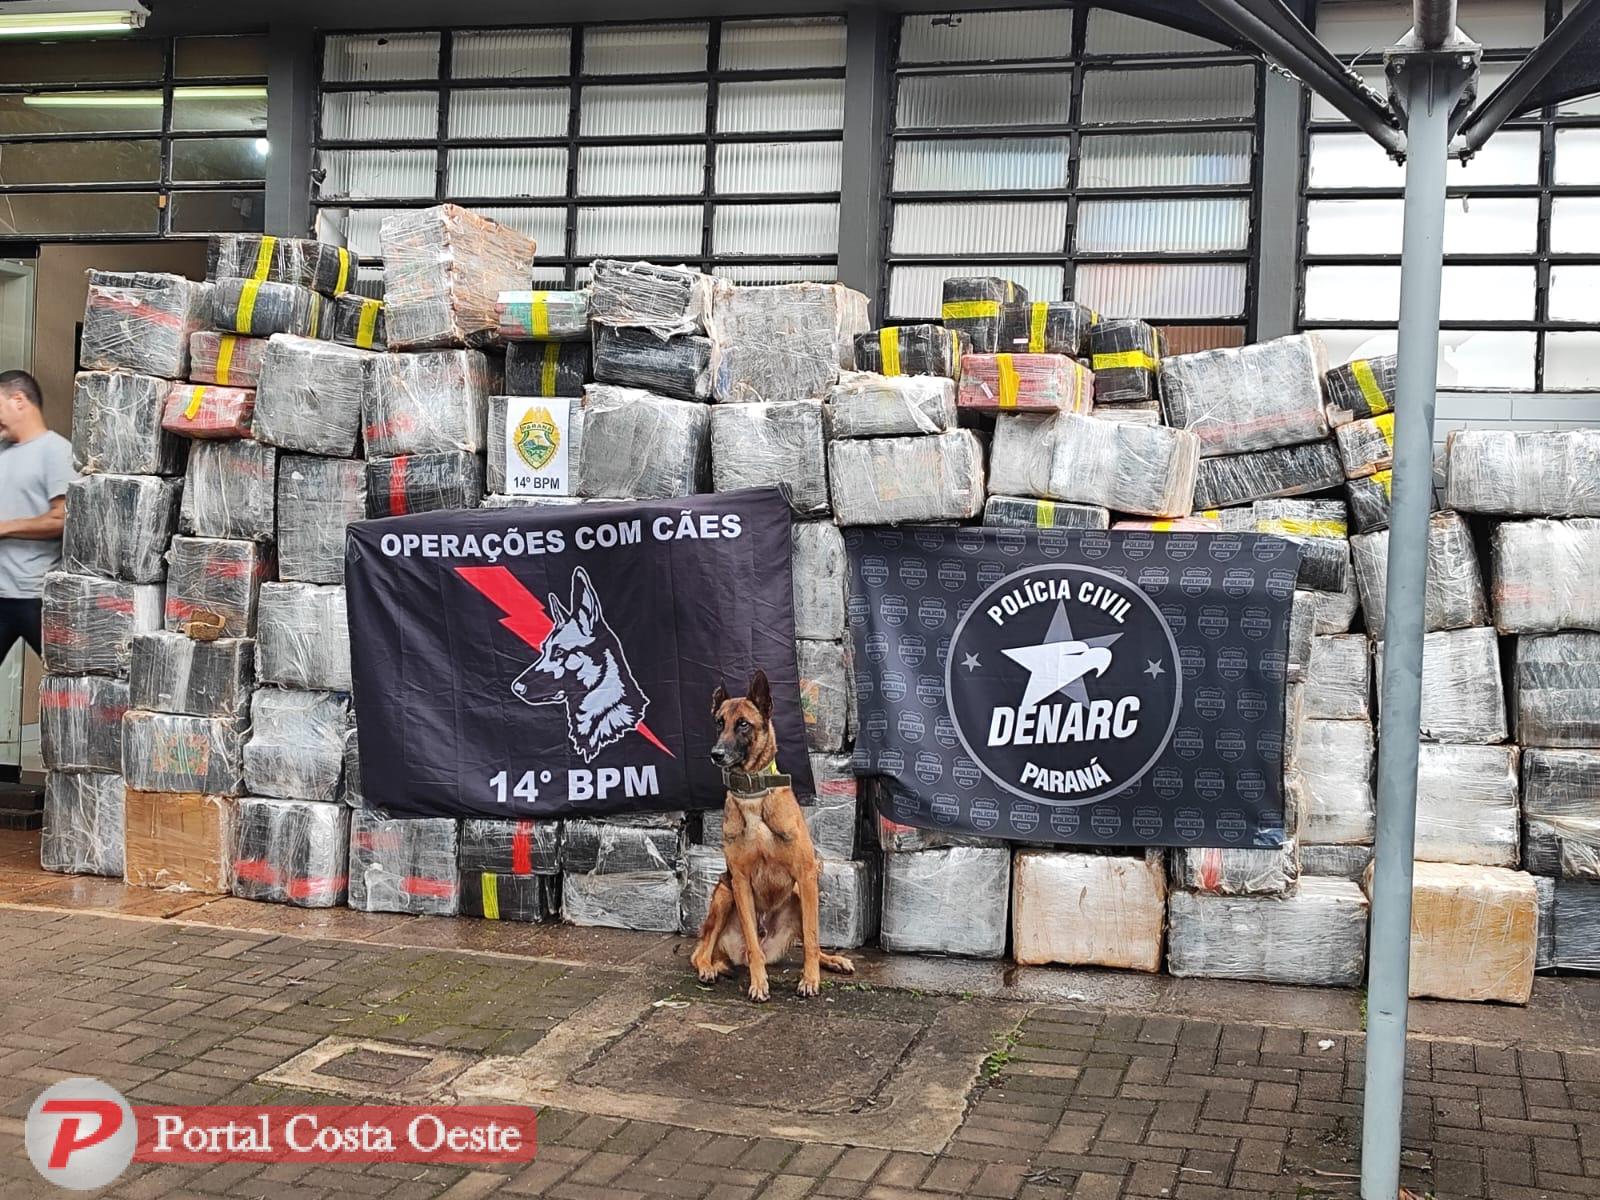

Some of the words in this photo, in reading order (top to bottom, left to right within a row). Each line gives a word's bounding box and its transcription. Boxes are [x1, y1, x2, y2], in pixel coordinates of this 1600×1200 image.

[534, 477, 560, 489] BPM
[380, 527, 565, 563] OPERAÇÕES
[575, 520, 642, 551] COM
[652, 510, 742, 541] CÃES
[987, 579, 1071, 626] POLÍCIA
[1078, 582, 1132, 624] CIVIL
[987, 695, 1141, 747] DENARC
[568, 765, 660, 801] BPM
[1020, 757, 1112, 793] PARANÁ
